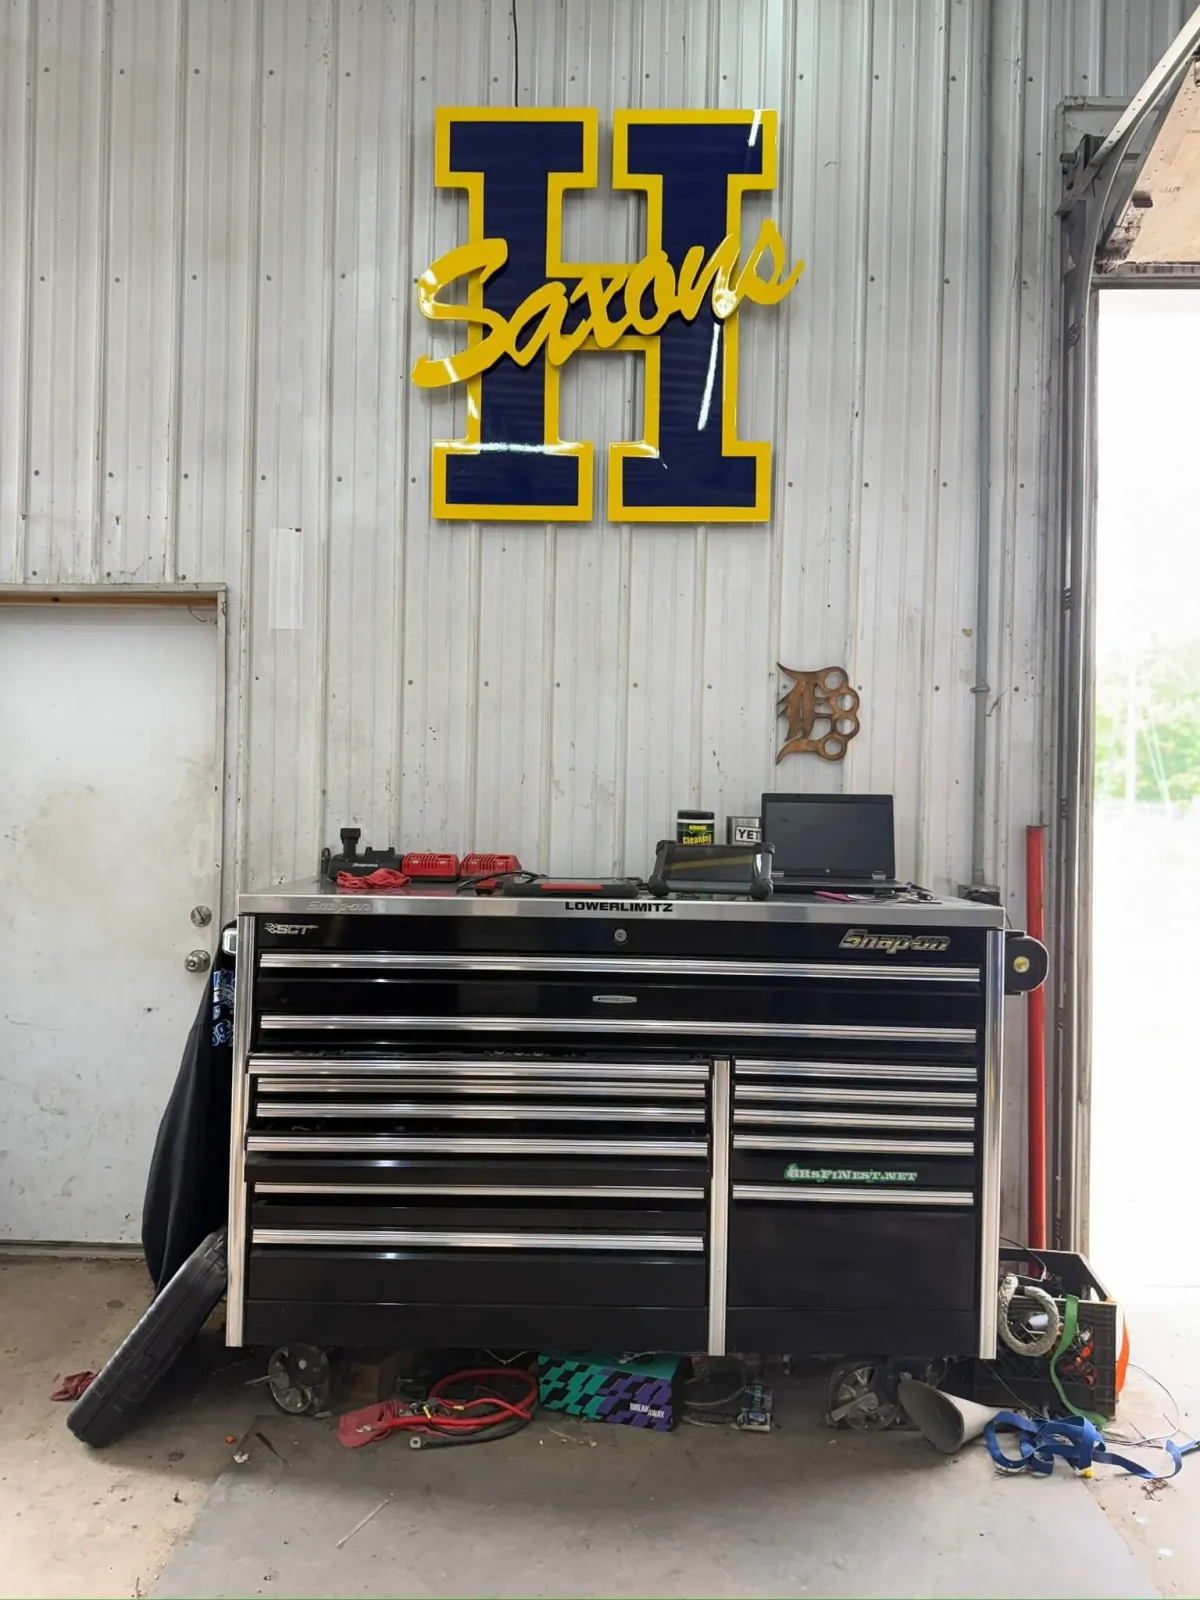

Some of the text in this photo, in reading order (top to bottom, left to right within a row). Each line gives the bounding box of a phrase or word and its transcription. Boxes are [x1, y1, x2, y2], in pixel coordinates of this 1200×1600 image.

[411, 218, 805, 389] Saxons
[432, 106, 778, 523] H
[565, 901, 674, 912] LOWERLIMITZ
[275, 924, 315, 935] SCT
[839, 928, 951, 954] Snap-on
